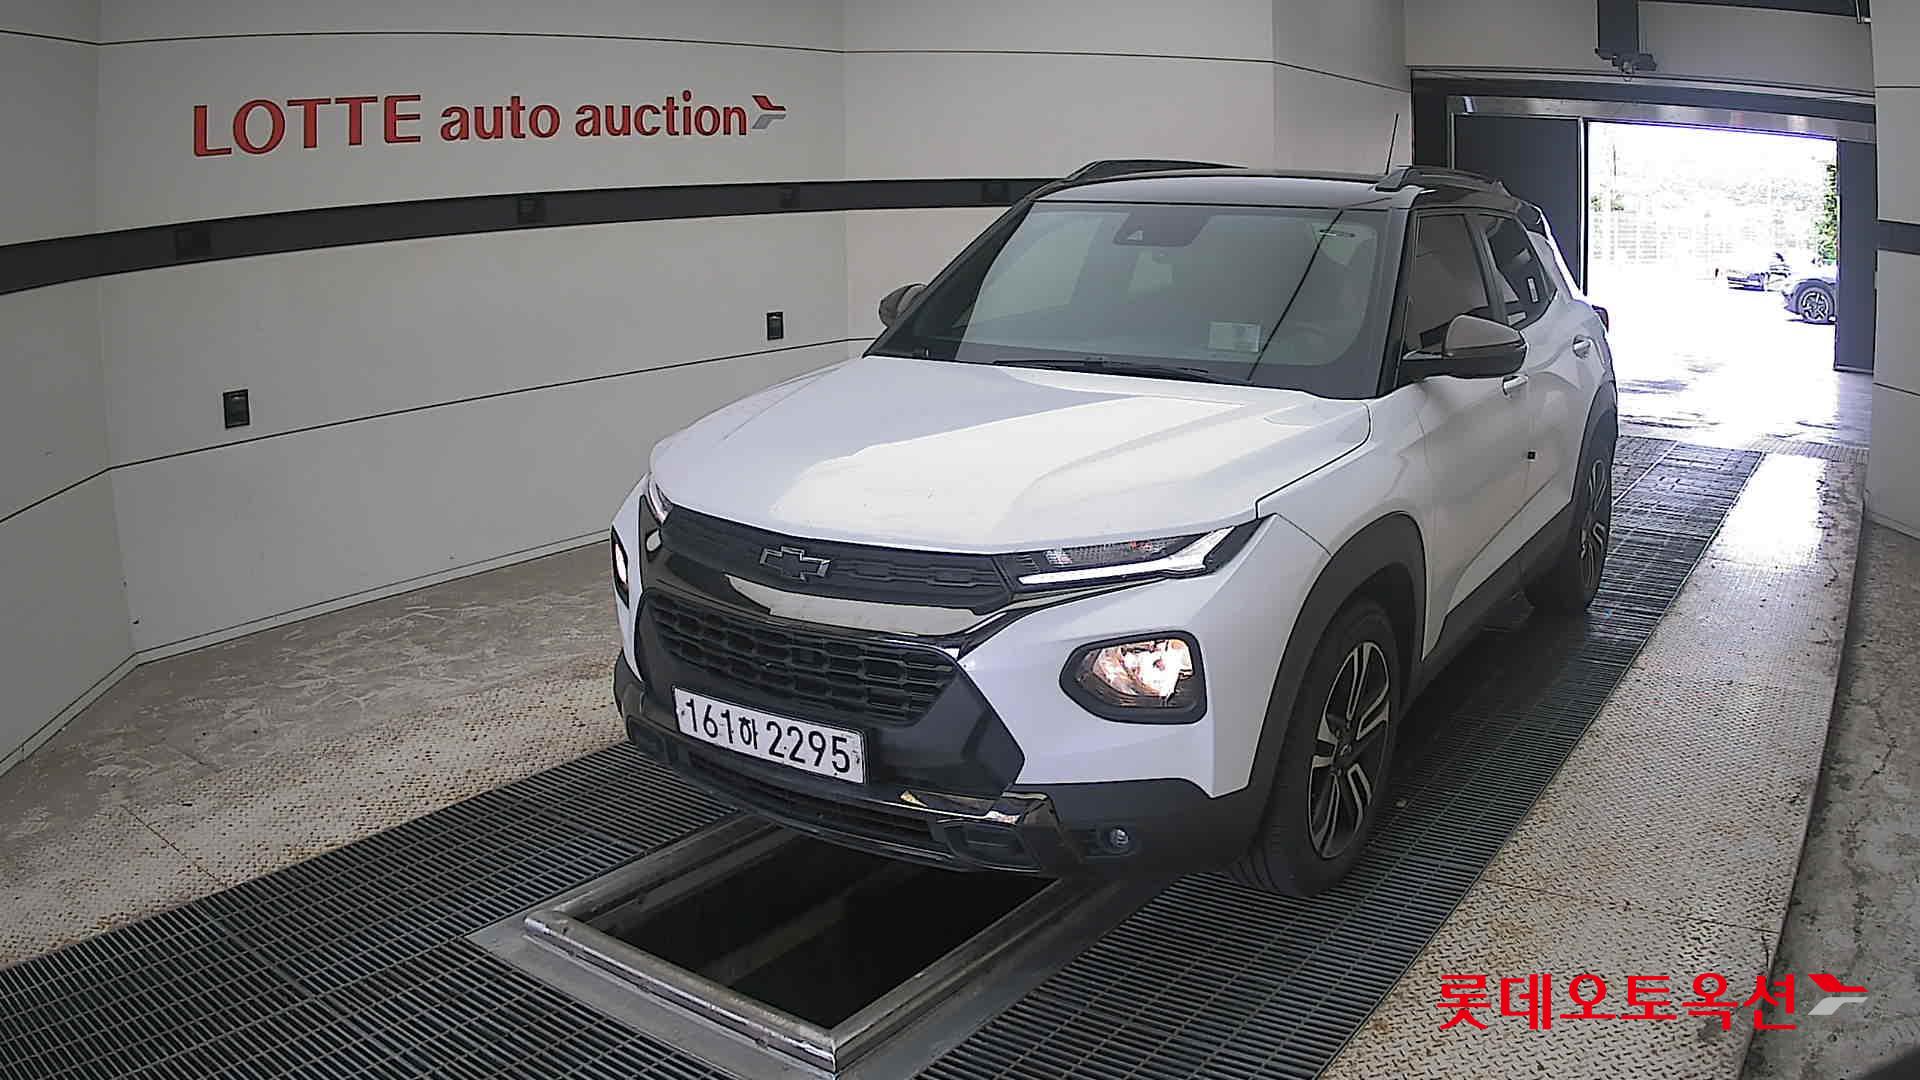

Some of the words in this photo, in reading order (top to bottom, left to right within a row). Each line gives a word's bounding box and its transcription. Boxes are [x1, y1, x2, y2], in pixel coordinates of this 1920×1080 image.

[193, 95, 421, 157] LOTTE
[439, 97, 561, 142] auto
[575, 90, 747, 137] auction
[686, 698, 758, 750] 161하
[766, 720, 850, 773] 2295
